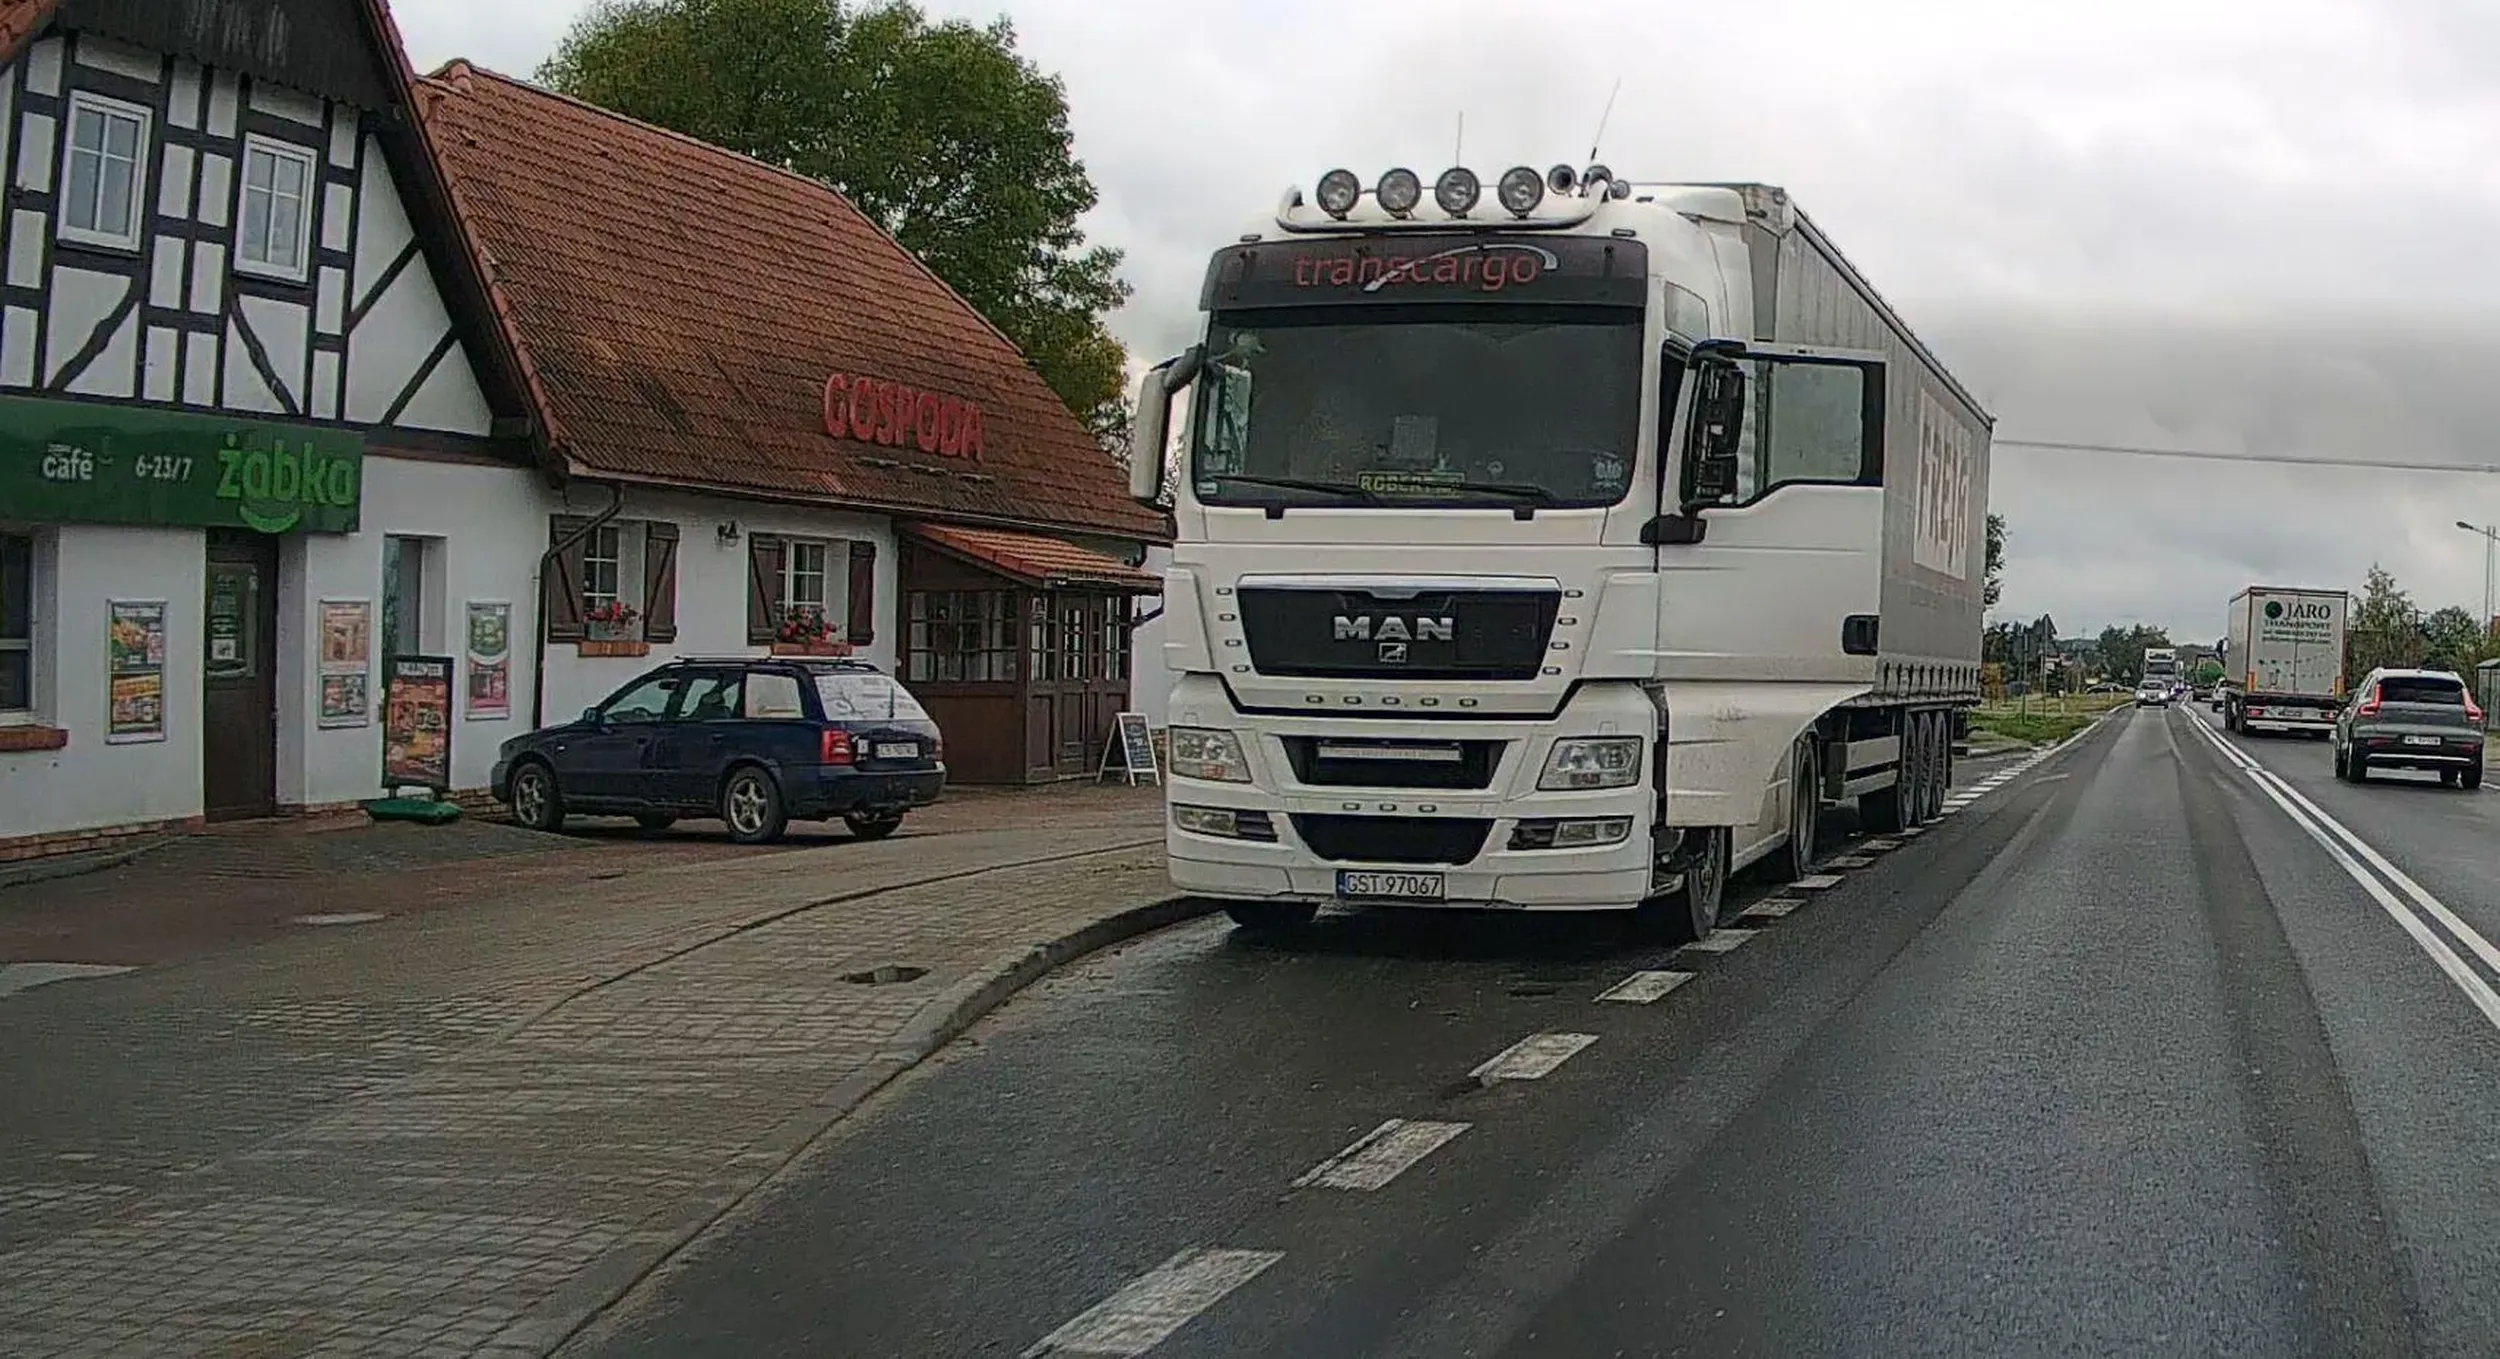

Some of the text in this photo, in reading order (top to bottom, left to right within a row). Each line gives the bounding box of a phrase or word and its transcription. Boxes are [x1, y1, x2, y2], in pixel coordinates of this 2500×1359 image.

[1293, 253, 1541, 291] transcargo
[824, 373, 983, 466] GOSPODA
[135, 455, 193, 480] 6-23/7
[215, 432, 357, 506] żabka
[2283, 602, 2331, 621] JARO
[1333, 615, 1454, 641] MAN
[1346, 874, 1440, 895] GST 97067
